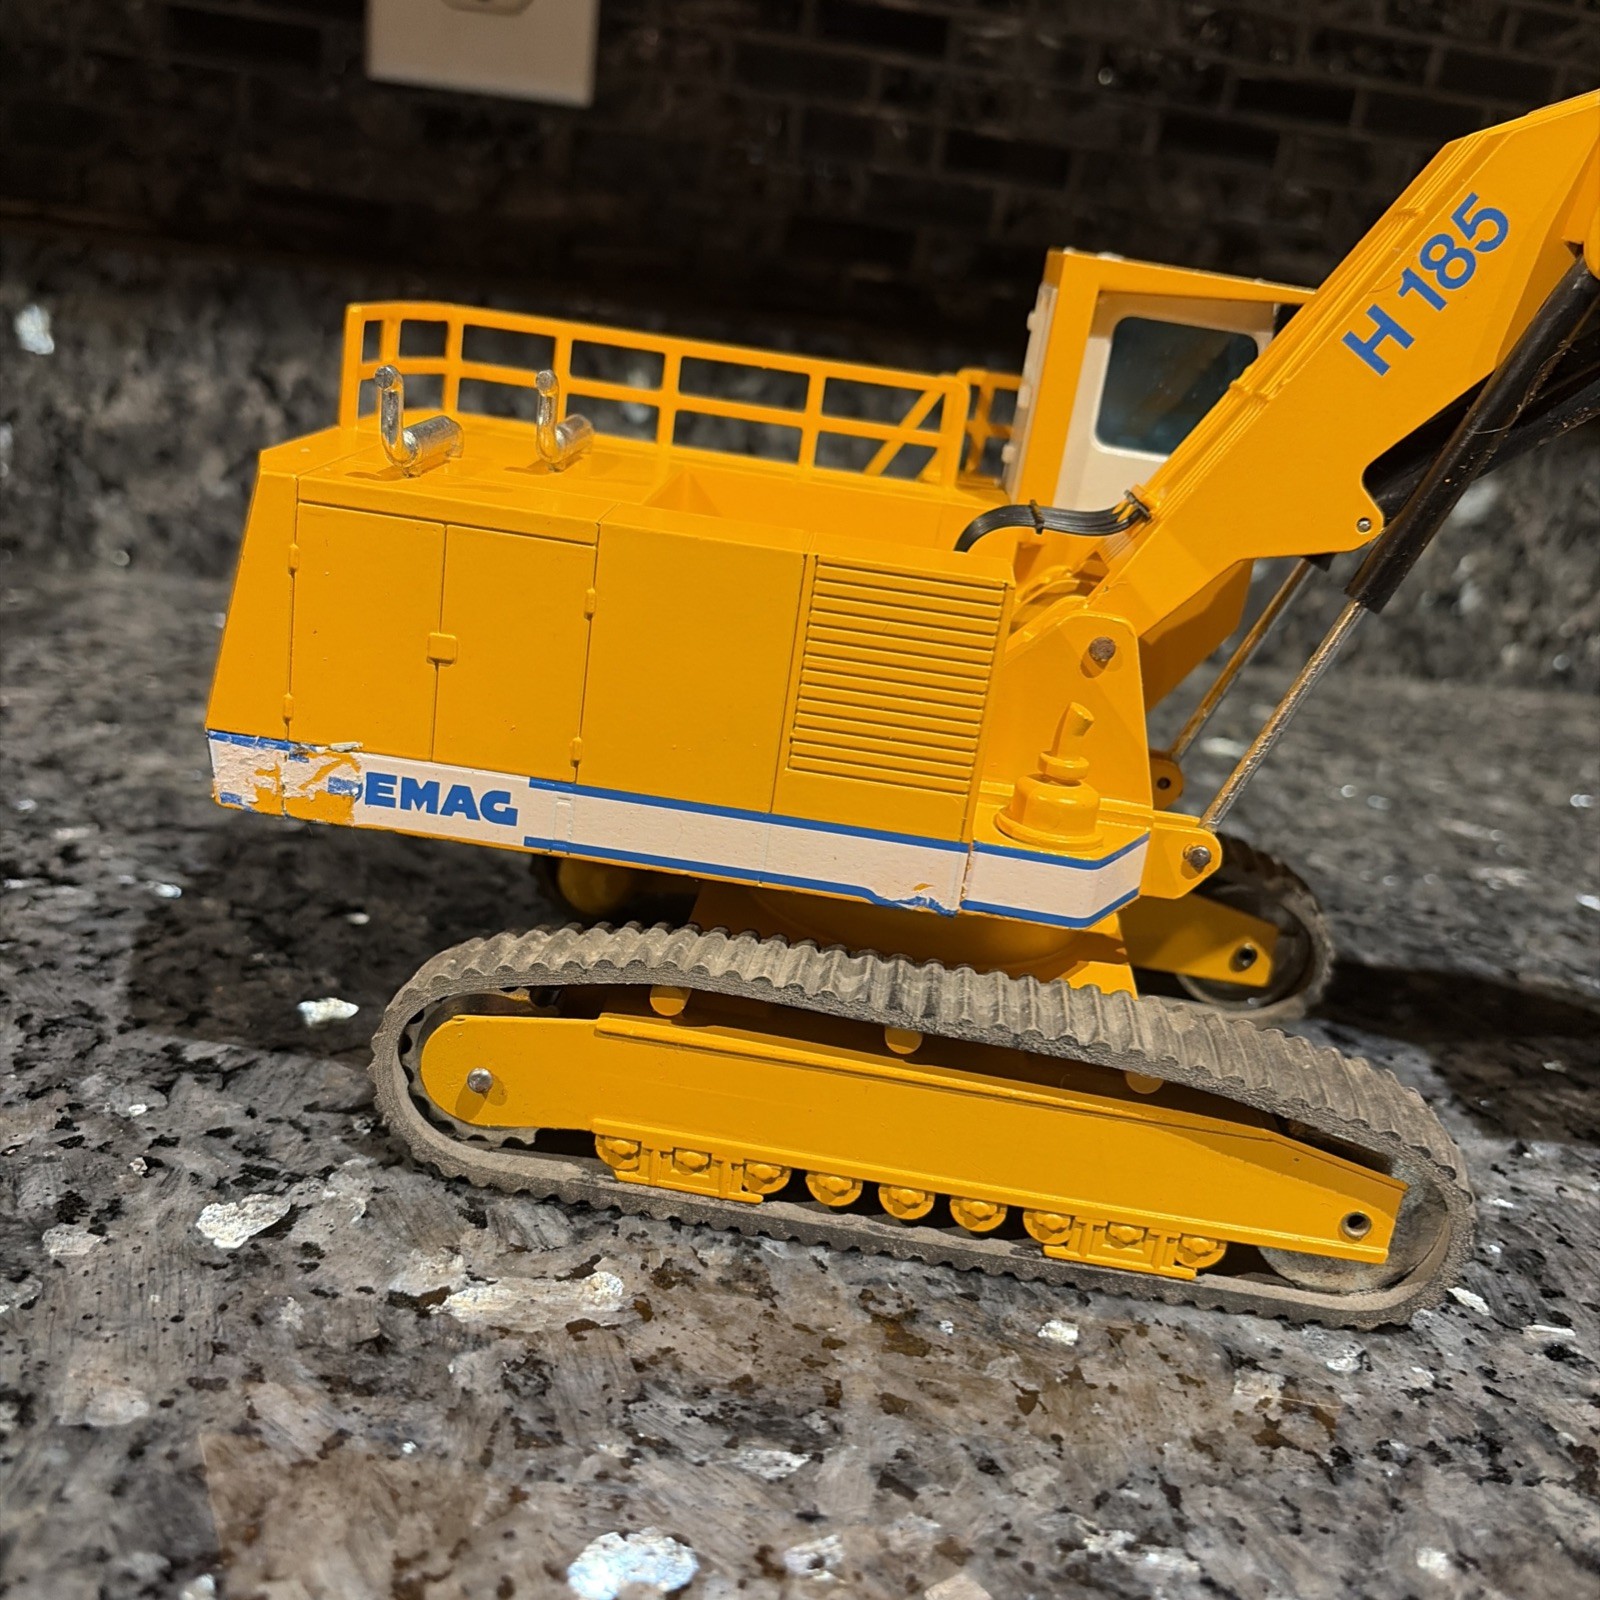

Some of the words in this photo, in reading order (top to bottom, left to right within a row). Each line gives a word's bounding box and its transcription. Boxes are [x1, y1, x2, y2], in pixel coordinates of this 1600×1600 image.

[1341, 303, 1415, 376] H
[1397, 192, 1509, 312] 185
[355, 771, 518, 827] EMAG
